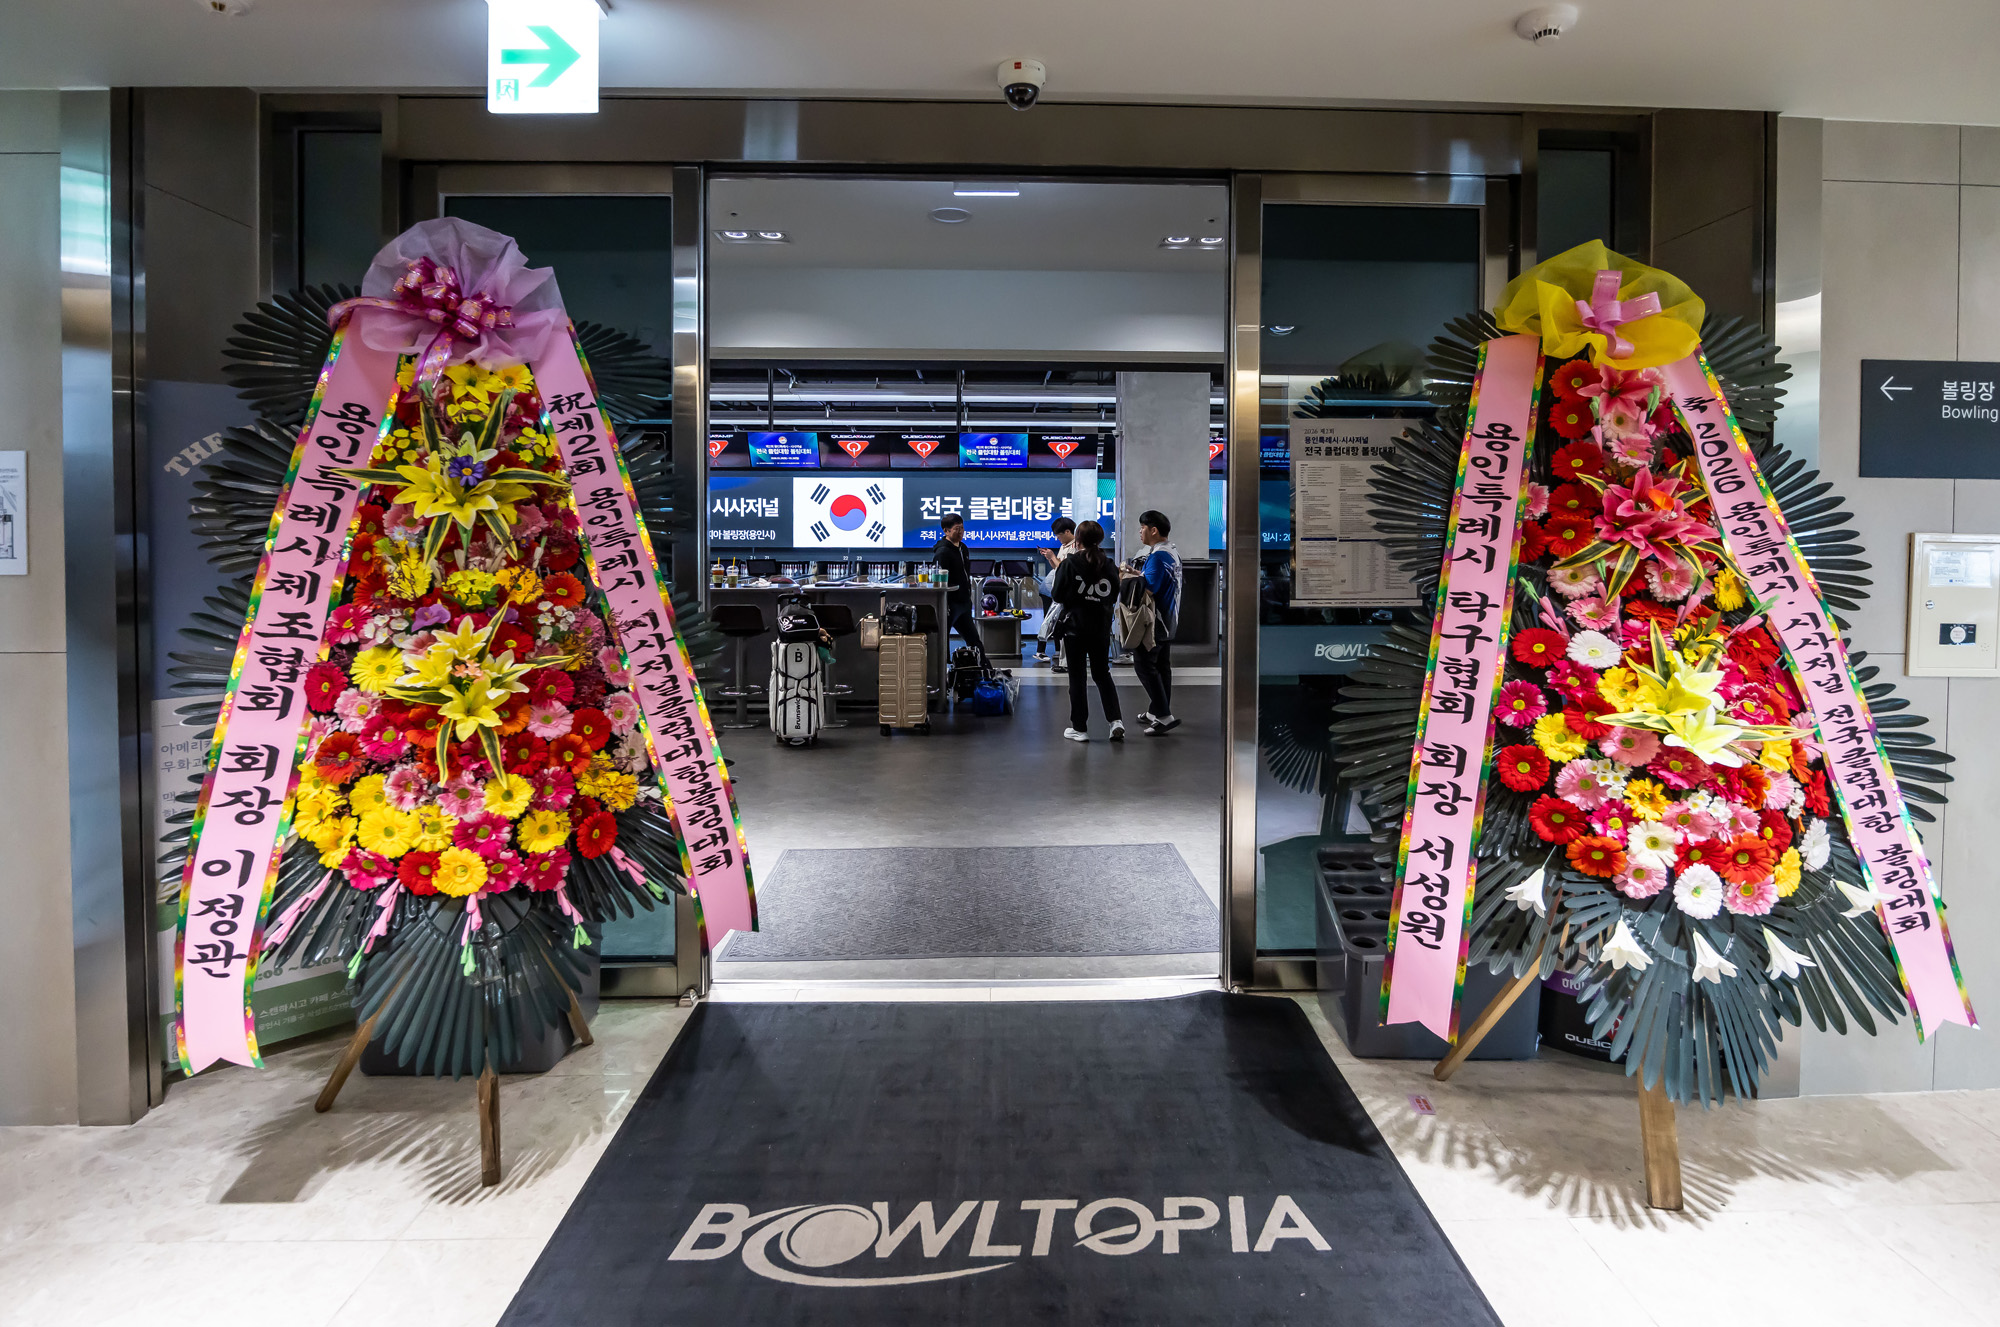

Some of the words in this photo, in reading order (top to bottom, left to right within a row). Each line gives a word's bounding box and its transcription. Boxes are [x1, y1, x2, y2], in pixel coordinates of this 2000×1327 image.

[1941, 380, 1995, 401] 볼링장
[1942, 405, 1999, 422] Bowling
[1304, 446, 1322, 456] 전국
[1324, 446, 1359, 456] 클럽대항
[712, 497, 779, 518] 시사저널
[919, 495, 964, 520] 전국
[968, 496, 1055, 521] 클럽대항
[919, 530, 937, 541] 주최
[1452, 422, 1521, 574] 용인특례시
[237, 402, 377, 721] 용인특례시체조협회
[1262, 532, 1278, 542] 일시
[1428, 591, 1501, 725] 탁구협회
[1695, 422, 1746, 494] 2026
[1871, 843, 1931, 935] 볼링대회
[211, 744, 284, 826] 회장
[1415, 742, 1473, 817] 회장
[187, 849, 256, 979] 이정관
[1400, 836, 1455, 950] 서성원
[1565, 1033, 1612, 1049] QUBIC
[667, 1195, 1332, 1287] BOWLTOPIA
